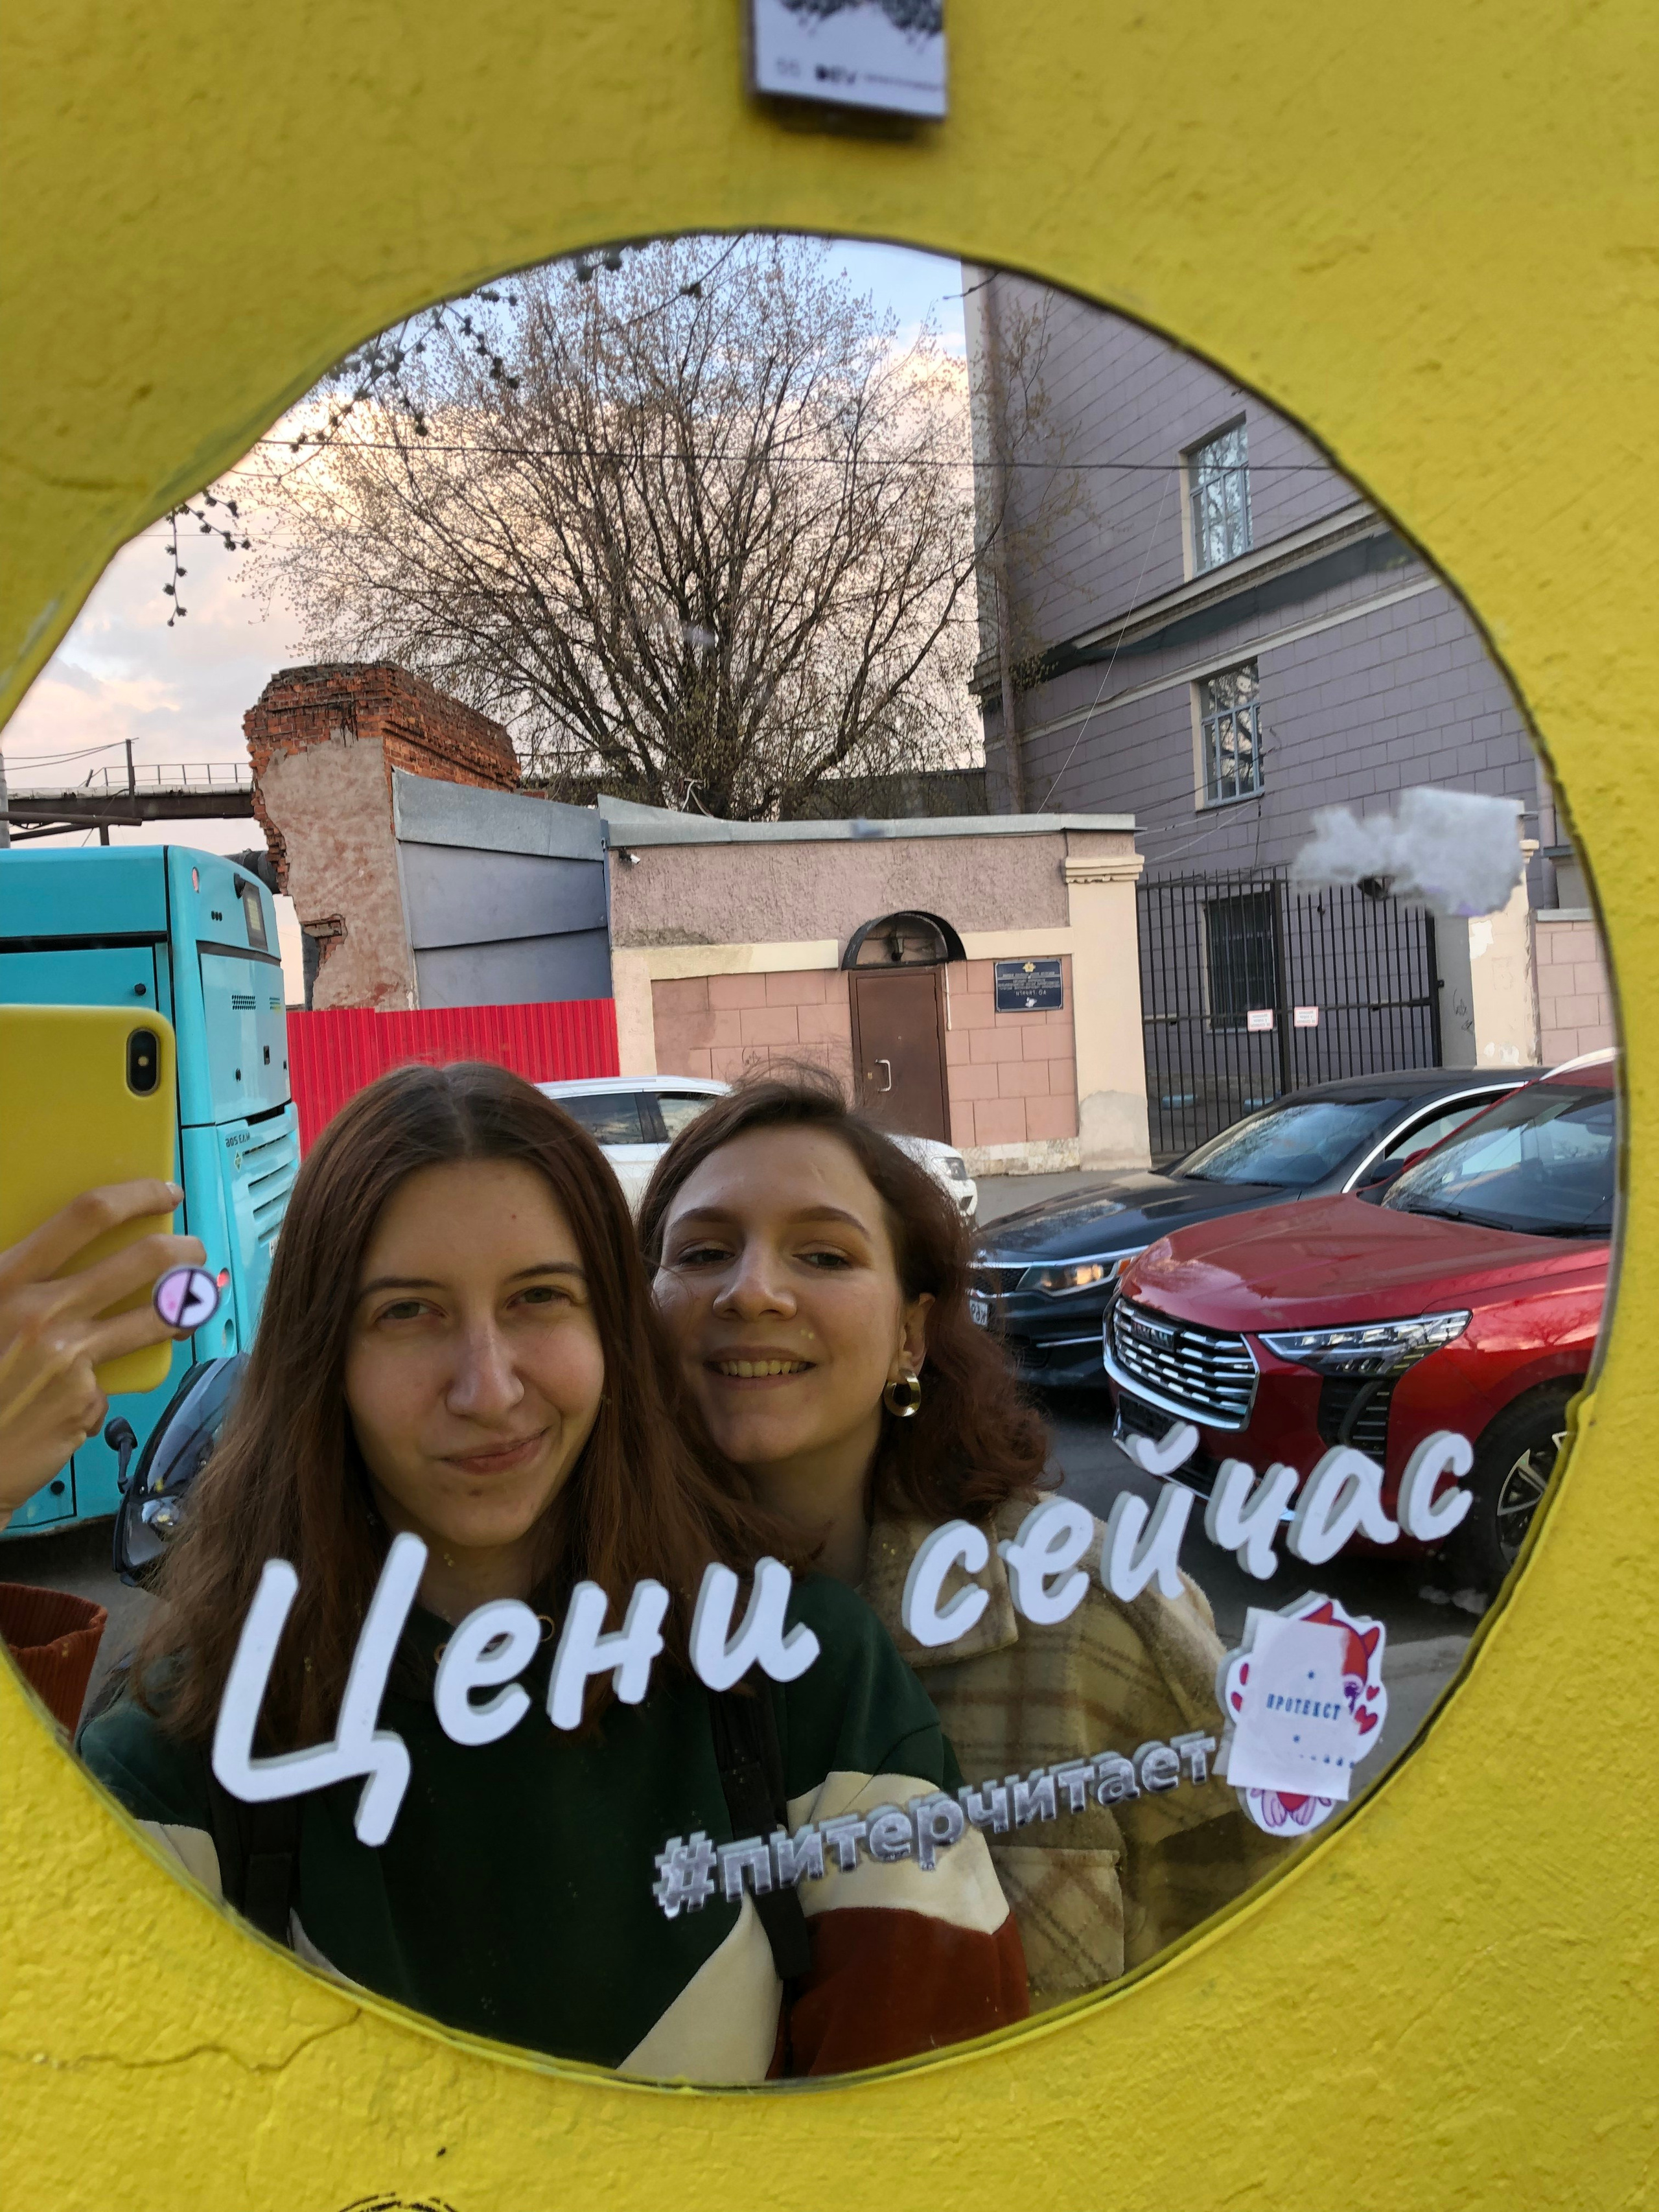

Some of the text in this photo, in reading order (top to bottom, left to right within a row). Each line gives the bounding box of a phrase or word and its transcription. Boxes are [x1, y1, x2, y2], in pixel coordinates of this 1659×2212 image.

[211, 1421, 1474, 1847] Цени сейчас
[652, 1729, 1217, 1920] #питерчитает
